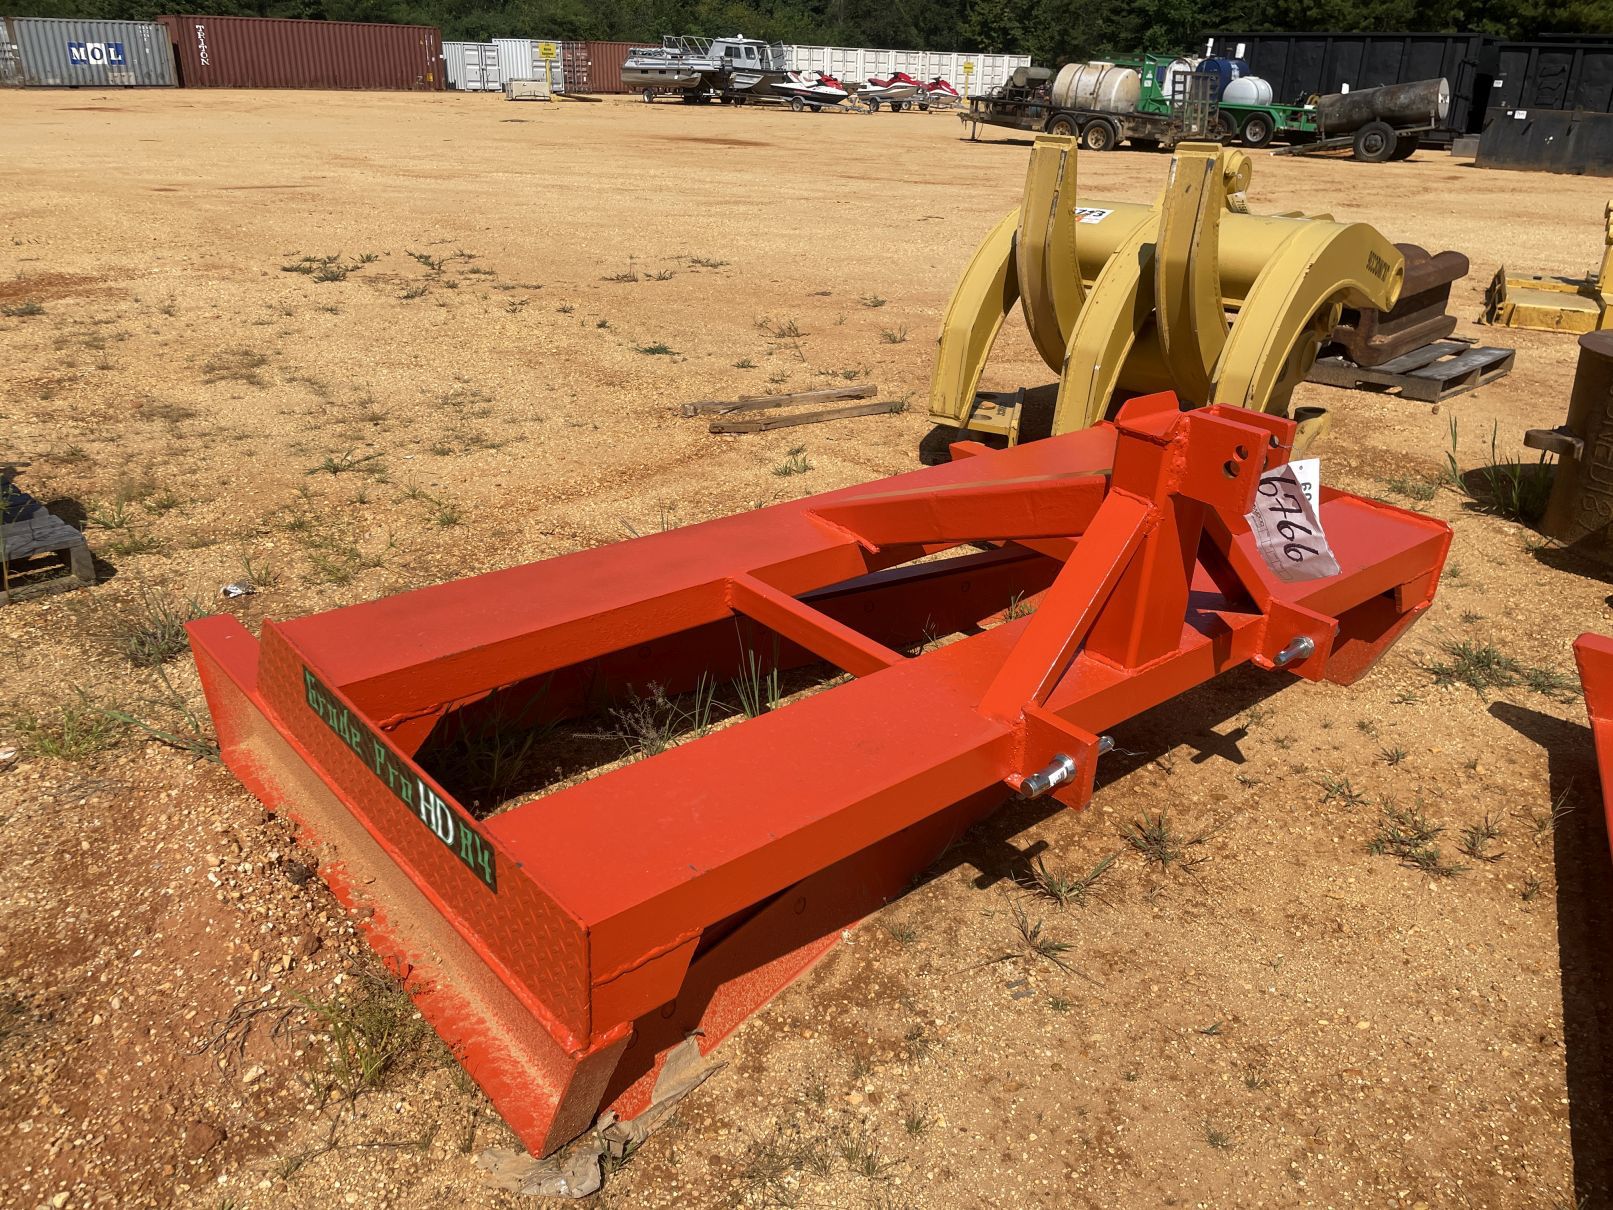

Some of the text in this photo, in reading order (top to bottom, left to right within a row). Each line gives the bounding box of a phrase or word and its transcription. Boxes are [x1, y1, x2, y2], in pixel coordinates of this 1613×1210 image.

[70, 46, 123, 61] MOL
[195, 24, 211, 66] TRITON
[1257, 476, 1320, 562] 6766
[304, 670, 492, 885] Grade Pro HD 84
